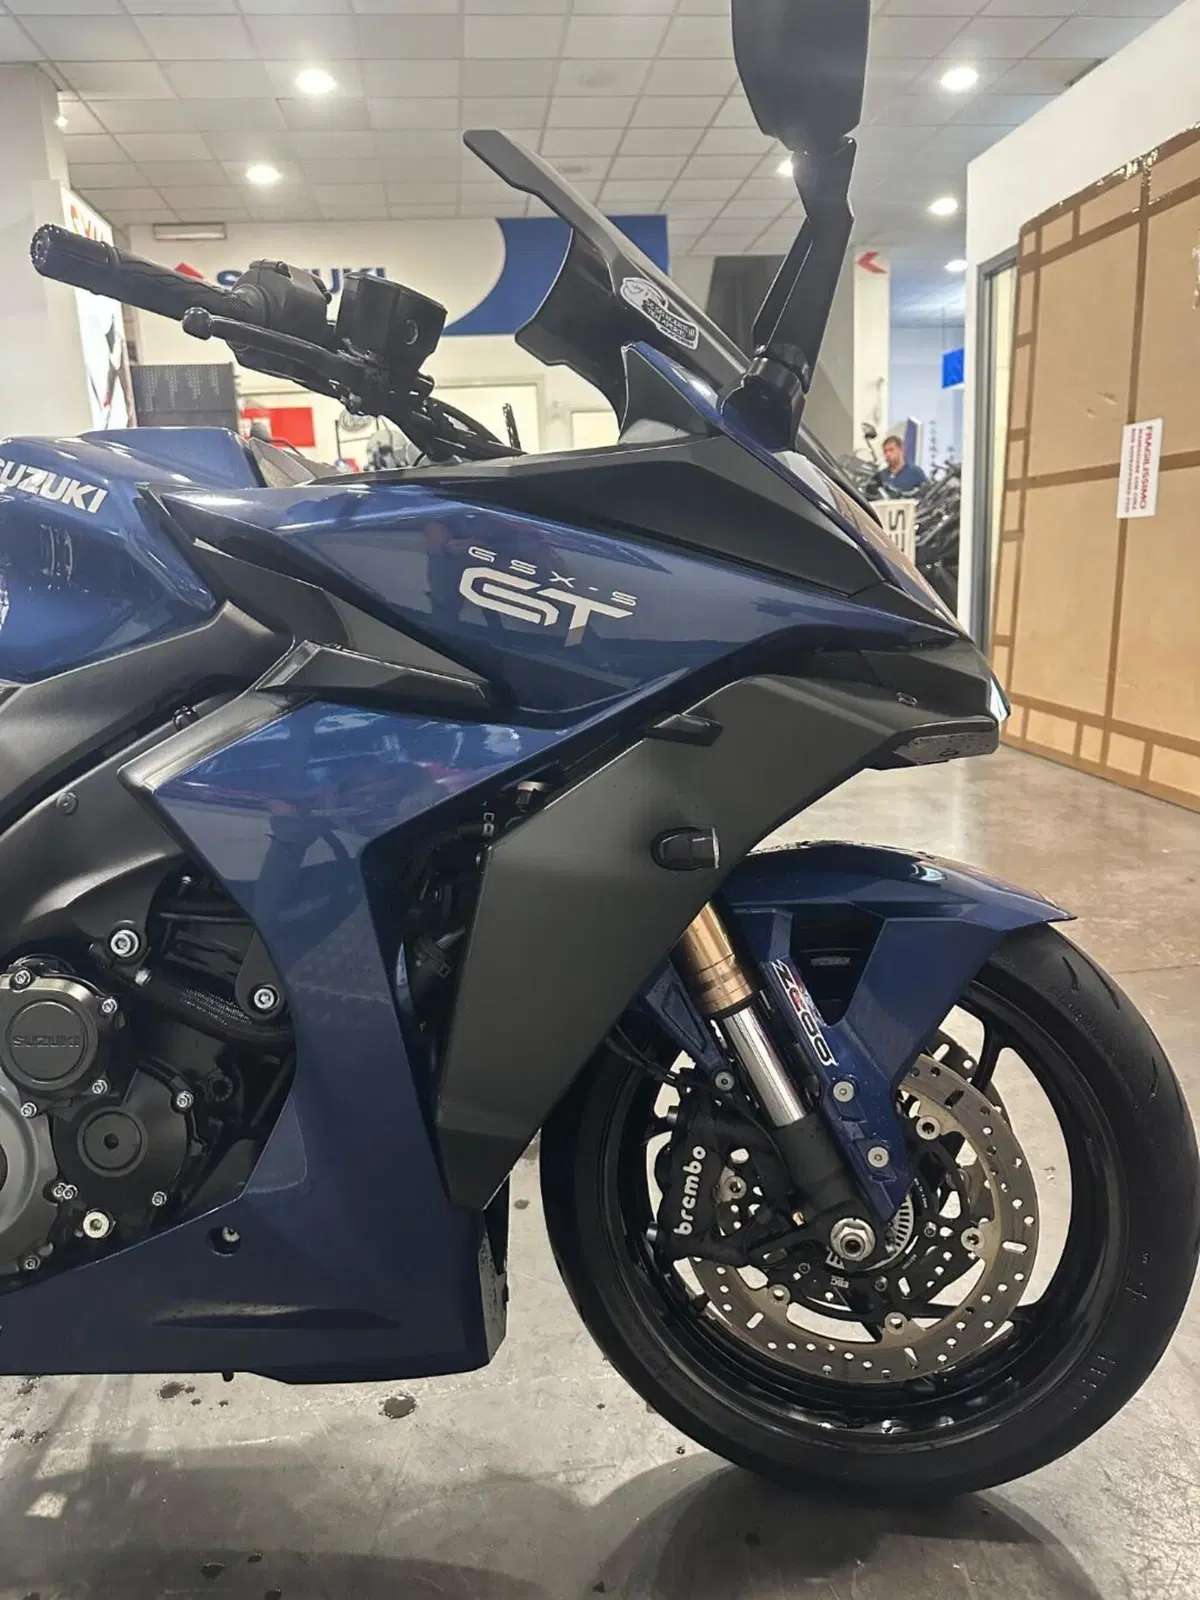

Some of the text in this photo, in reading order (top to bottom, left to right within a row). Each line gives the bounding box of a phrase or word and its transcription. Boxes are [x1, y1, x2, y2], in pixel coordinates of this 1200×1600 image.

[1138, 425, 1153, 509] FRAGILISSIMO
[459, 567, 633, 647] GT
[12, 1035, 80, 1048] SUZUKI
[673, 1146, 706, 1235] brembo
